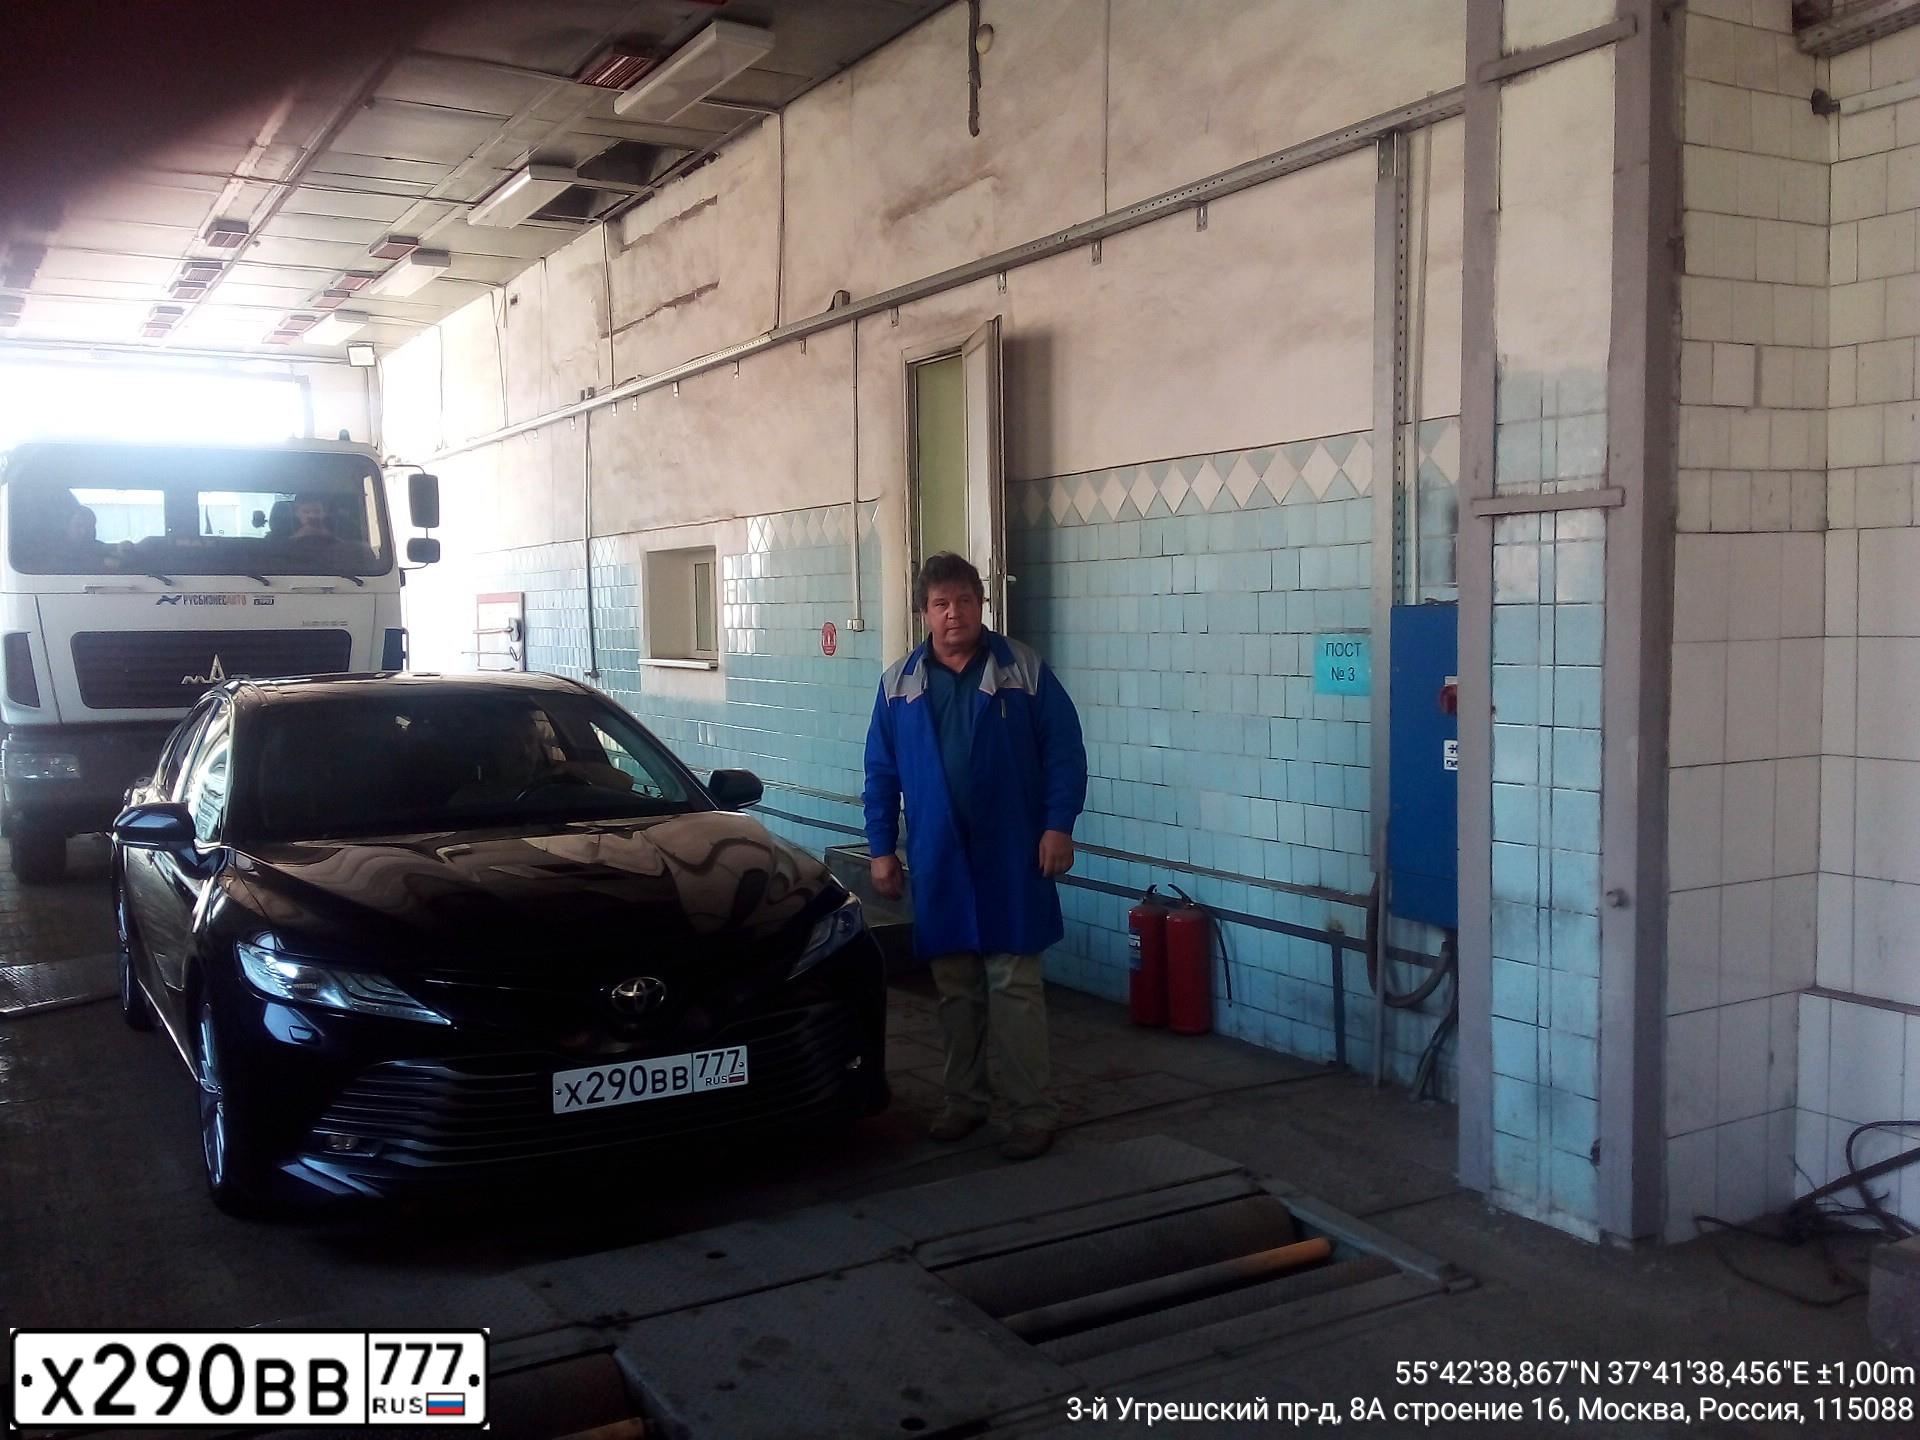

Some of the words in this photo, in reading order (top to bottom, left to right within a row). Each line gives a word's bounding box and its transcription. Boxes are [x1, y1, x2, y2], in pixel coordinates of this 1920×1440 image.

[1325, 642, 1362, 657] ПОСТ
[695, 1050, 740, 1078] 777
[564, 1064, 689, 1107] Х290ВВ
[705, 1075, 728, 1087] RUS
